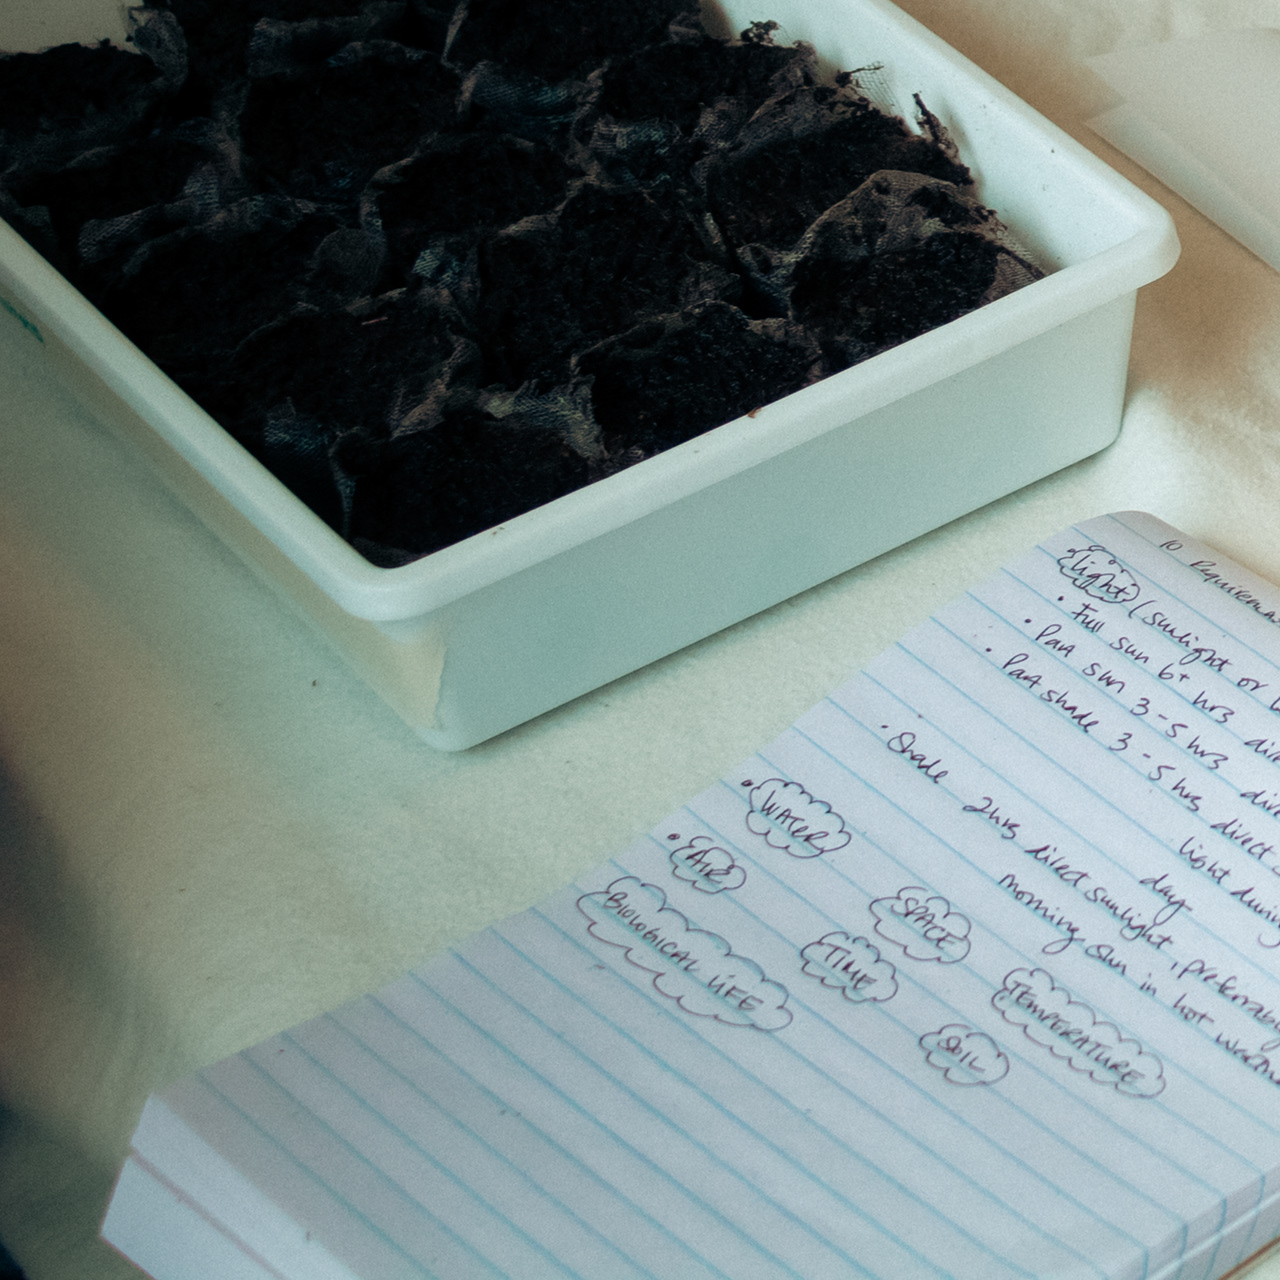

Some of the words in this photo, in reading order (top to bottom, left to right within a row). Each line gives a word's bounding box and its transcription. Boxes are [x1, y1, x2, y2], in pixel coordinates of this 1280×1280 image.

[1070, 602, 1106, 634] Full
[1109, 636, 1150, 664] sun
[1082, 662, 1126, 694] sun
[1237, 676, 1269, 693] or
[1039, 689, 1100, 734] shade
[1209, 818, 1276, 861] direct
[1024, 844, 1092, 888] direct
[1179, 835, 1232, 885] light
[890, 896, 960, 952] SPACE
[1139, 873, 1194, 927] day
[818, 941, 879, 991] TIME
[1139, 972, 1157, 997] in
[1171, 992, 1215, 1024] hot
